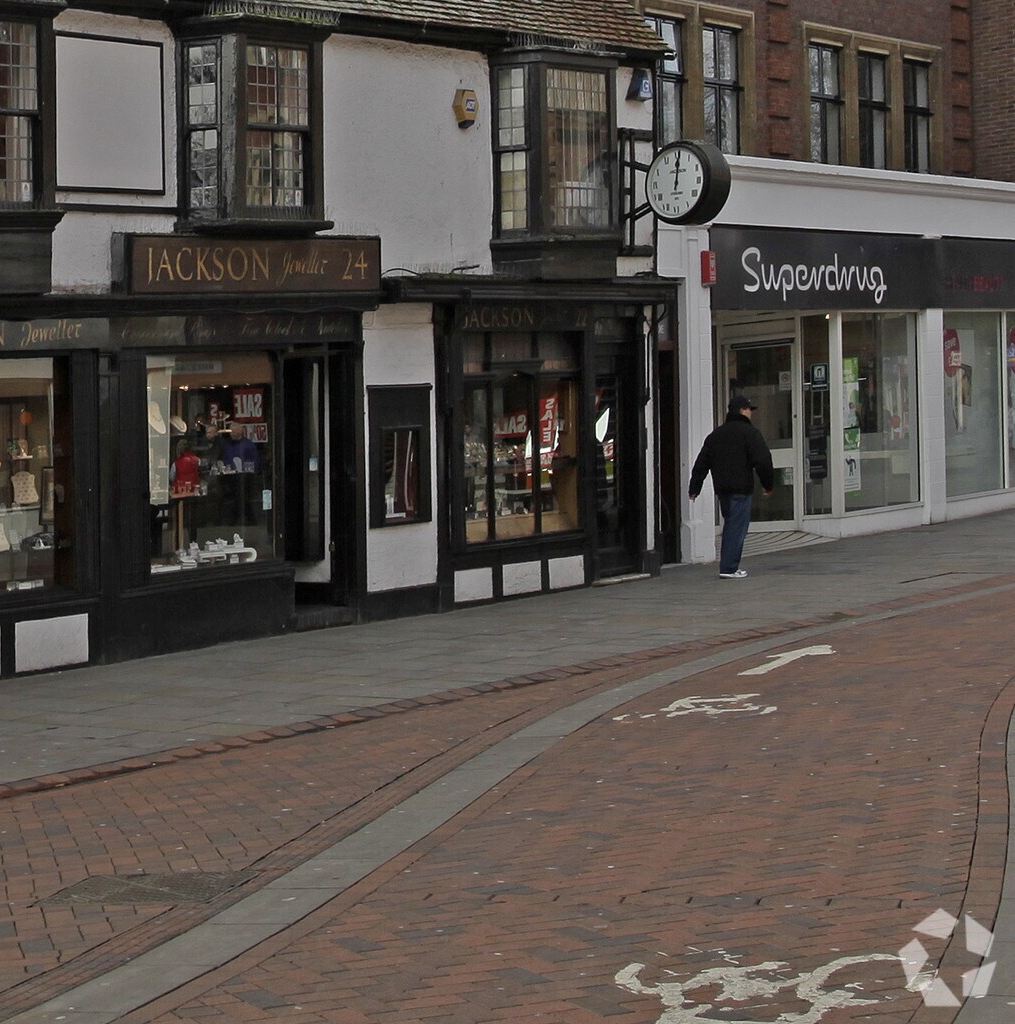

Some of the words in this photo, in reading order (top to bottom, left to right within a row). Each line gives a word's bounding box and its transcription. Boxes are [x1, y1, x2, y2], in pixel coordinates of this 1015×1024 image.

[147, 247, 270, 285] JACKSON
[275, 247, 328, 287] Jeweller
[342, 248, 369, 281] 24
[741, 246, 888, 304] Superdrug
[19, 319, 82, 348] Jeweller
[462, 306, 534, 330] JACKSON
